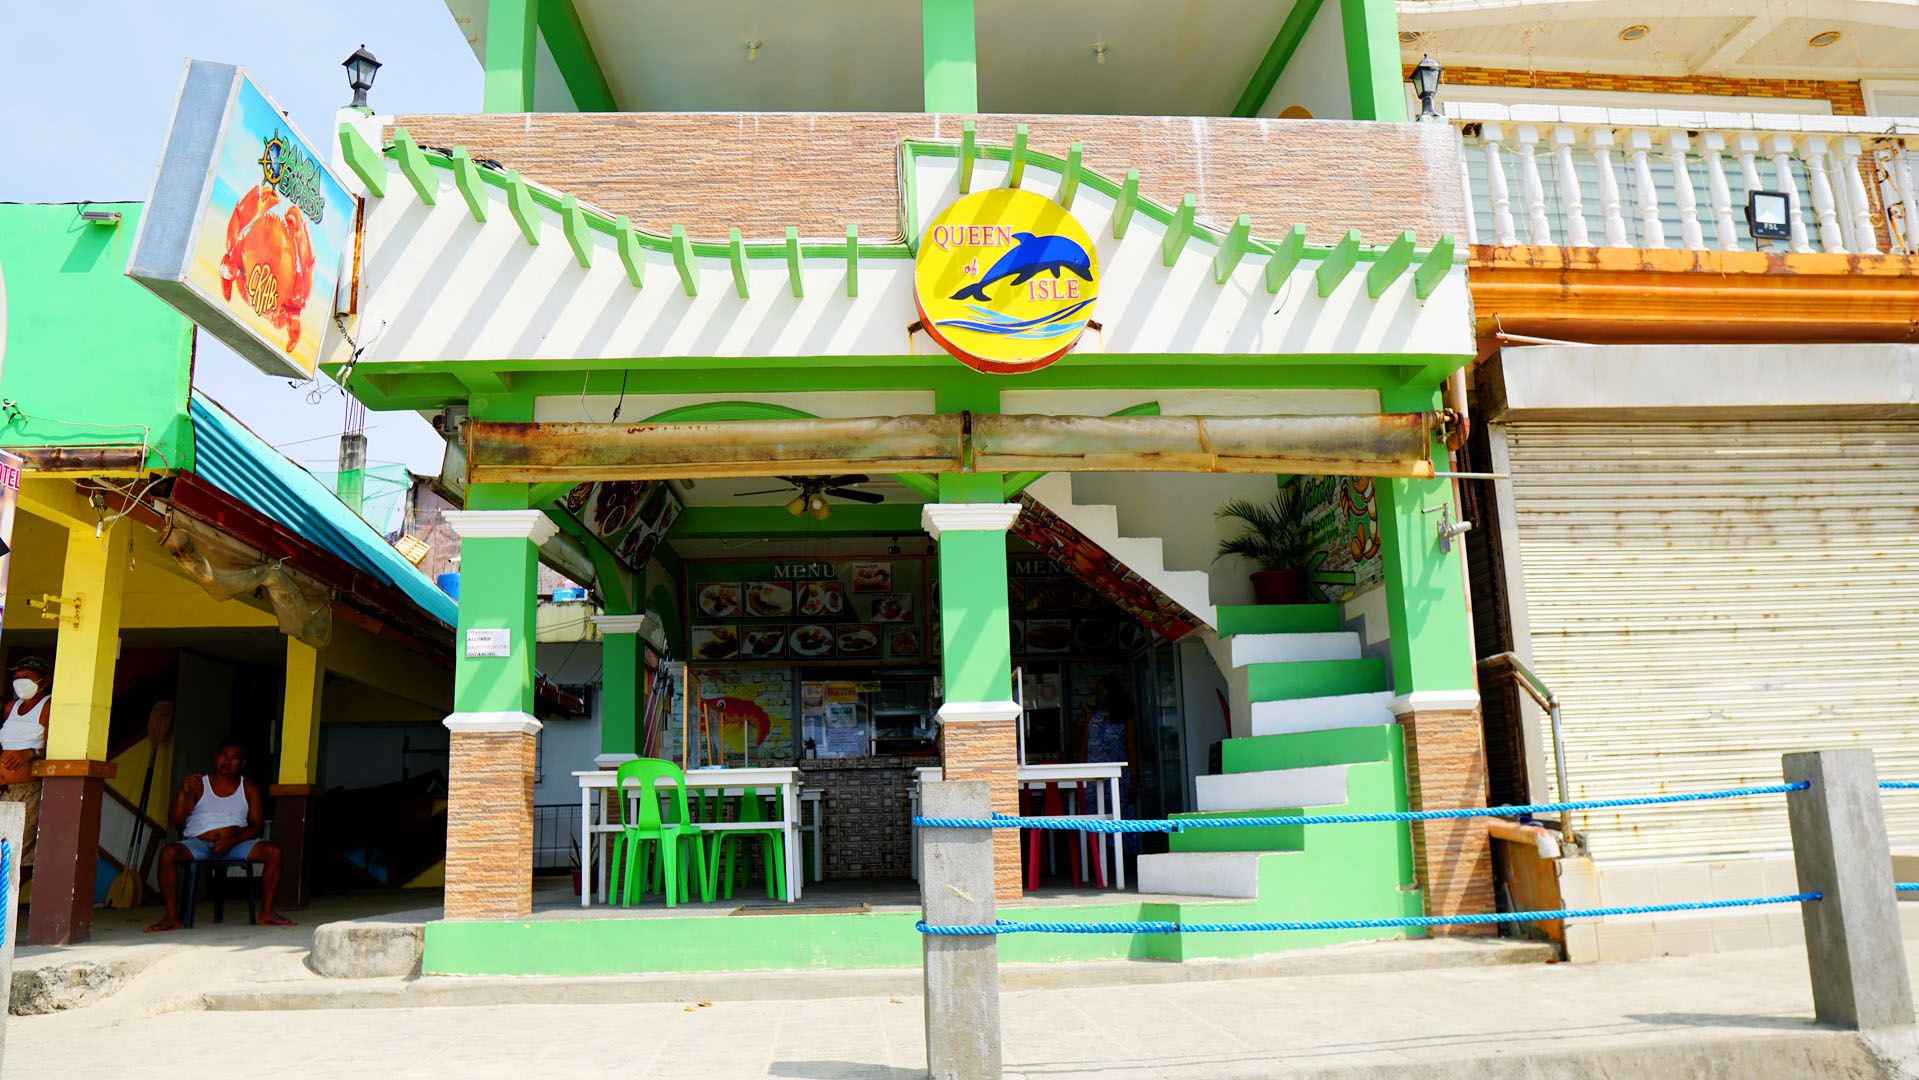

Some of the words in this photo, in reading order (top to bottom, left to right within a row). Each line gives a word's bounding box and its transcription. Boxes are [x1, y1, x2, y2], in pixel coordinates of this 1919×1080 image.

[278, 136, 321, 196] DAMPA
[279, 168, 325, 224] EXPRESS
[1764, 223, 1778, 231] FSL
[933, 225, 1011, 251] QUEEN
[964, 258, 977, 276] of
[1028, 279, 1080, 300] ISLE
[773, 563, 836, 578] MENU
[1016, 560, 1066, 575] MEN
